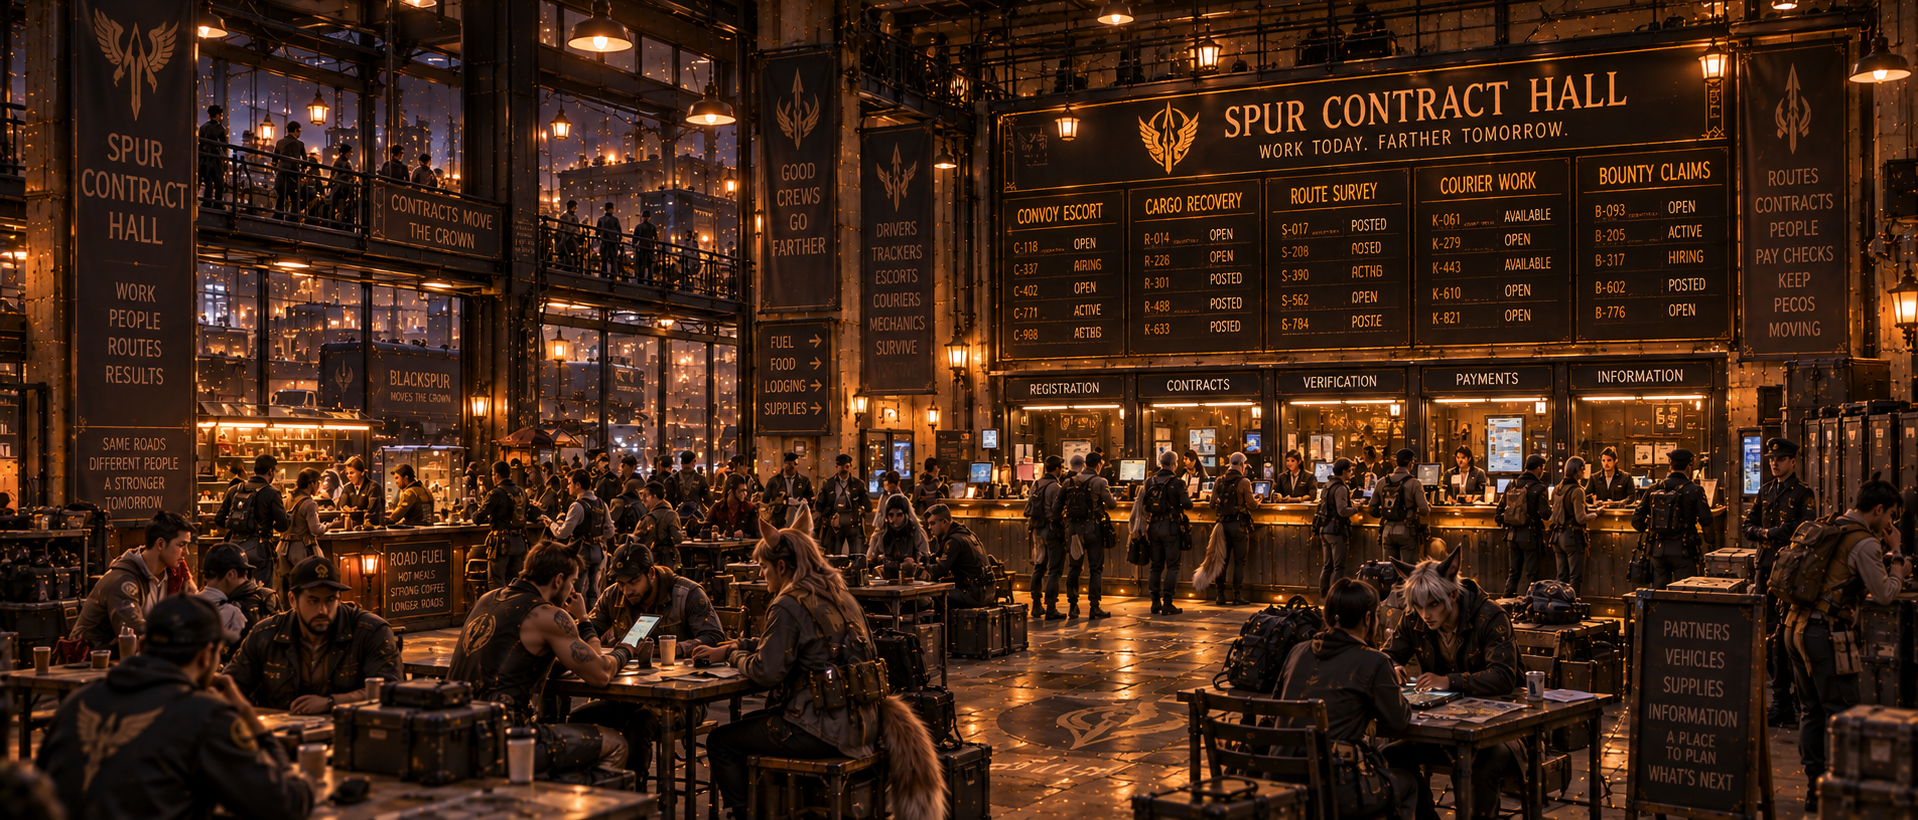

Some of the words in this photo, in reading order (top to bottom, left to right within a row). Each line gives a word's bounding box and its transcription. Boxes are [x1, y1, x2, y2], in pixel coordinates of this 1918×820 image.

[1224, 100, 1307, 139] SPUR
[1322, 80, 1509, 129] CONTRACT
[1528, 70, 1628, 113] HALL
[1259, 141, 1304, 159] WORK
[1312, 136, 1368, 156] TODAY.
[1378, 130, 1452, 150] FARTHER
[1461, 121, 1568, 144] TOMORROW.
[107, 132, 163, 169] SPUR
[781, 162, 815, 181] GOOD
[1599, 164, 1655, 185] BOUNTY
[1660, 160, 1711, 182] CLAIMS
[1768, 167, 1819, 187] ROUTES
[81, 168, 188, 210] CONTRACT
[1440, 174, 1493, 195] COURIER
[1498, 171, 1537, 191] WORK
[776, 186, 820, 207] CREWS
[1290, 185, 1328, 205] ROUTE
[1333, 182, 1378, 202] SURVEY
[391, 194, 459, 223] CONTRACTS
[463, 209, 493, 231] MOVE
[1145, 196, 1182, 215] CARGO
[1187, 192, 1243, 212] RECOVERY
[1595, 203, 1626, 218] B-093
[1668, 200, 1696, 214] OPEN
[1755, 193, 1834, 214] CONTRACTS
[789, 212, 808, 231] GO
[1017, 205, 1059, 224] CONVOY
[1063, 202, 1103, 221] ESCORT
[1432, 213, 1460, 227] K-061
[1504, 207, 1551, 223] AVAILABLE
[109, 211, 163, 245] HALL
[409, 222, 431, 242] THE
[435, 227, 475, 249] CROWN
[876, 220, 917, 238] DRIVERS
[1281, 222, 1309, 236] S-017
[1351, 217, 1387, 232] POSTED
[1595, 228, 1626, 242] B-205
[1668, 224, 1703, 239] ACTIVE
[1770, 219, 1819, 238] PEOPLE
[1013, 240, 1039, 254] C-118
[1073, 237, 1096, 250] OPEN
[1144, 232, 1170, 246] R-014
[1209, 227, 1233, 241] OPEN
[1432, 236, 1461, 250] K-279
[1504, 232, 1531, 247] OPEN
[772, 236, 826, 257] FARTHER
[871, 244, 922, 262] TRACKERS
[1281, 245, 1309, 258] S-208
[1756, 247, 1779, 265] PAY
[1783, 245, 1834, 264] CHECKS
[1144, 254, 1170, 267] R-226
[1209, 249, 1234, 263] OPEN
[1432, 261, 1461, 274] K-443
[1504, 256, 1551, 271] AVAILABLE
[1595, 253, 1625, 267] B-317
[1668, 249, 1704, 264] HIRING
[875, 268, 918, 285] ESCORTS
[1013, 262, 1039, 276] C-337
[1281, 268, 1310, 282] S-390
[1144, 277, 1170, 290] R-301
[1210, 272, 1243, 285] POSTED
[1595, 280, 1626, 294] B-602
[1668, 277, 1706, 292] POSTED
[1778, 271, 1811, 288] KEEP
[115, 282, 156, 303] WORK
[1013, 284, 1039, 297] C-402
[1073, 281, 1096, 294] OPEN
[1432, 286, 1461, 300] K-610
[1504, 284, 1531, 297] OPEN
[873, 291, 921, 308] COURIERS
[1144, 300, 1170, 313] R-488
[1210, 296, 1243, 310] POSTED
[1281, 293, 1309, 307] S-562
[1351, 290, 1378, 304] OPEN
[1774, 296, 1815, 313] PECOS
[109, 309, 161, 330] PEOPLE
[1013, 306, 1038, 319] C-771
[1073, 303, 1102, 317] ACTIVE
[1432, 311, 1460, 325] K-821
[1504, 308, 1531, 322] OPEN
[1595, 305, 1626, 320] B-776
[1668, 303, 1696, 317] OPEN
[869, 315, 925, 332] MECHANICS
[1210, 320, 1241, 333] POSTED
[1769, 320, 1821, 338] MOVING
[108, 337, 161, 358] ROUTES
[770, 335, 794, 349] FUEL
[876, 339, 917, 356] SURVIVE
[770, 357, 796, 371] FOOD
[105, 365, 164, 385] RESULTS
[390, 369, 450, 389] BLACKSPUR
[1303, 374, 1377, 389] VERIFICATION
[1455, 372, 1519, 386] PAYMENTS
[1597, 368, 1683, 384] INFORMATION
[764, 379, 806, 393] LODGING
[1029, 381, 1100, 396] REGISTRATION
[1166, 378, 1230, 392] CONTRACTS
[390, 391, 413, 402] MOVES
[415, 392, 426, 402] THE
[764, 401, 807, 416] SUPPLIES
[102, 437, 130, 451] SAME
[134, 437, 166, 451] ROADS
[89, 457, 141, 471] DIFFERENT
[144, 457, 179, 470] PEOPLE
[104, 477, 111, 490] A
[115, 476, 165, 490] STRONGER
[105, 496, 163, 510] TOMORROW
[390, 551, 418, 566] ROAD
[421, 549, 446, 564] FUEL
[398, 571, 412, 582] HOT
[414, 570, 436, 580] MEALS
[1663, 620, 1730, 641] PARTNERS
[1665, 648, 1725, 670] VEHICLES
[1663, 675, 1724, 698] SUPPLIES
[1648, 703, 1738, 728] INFORMATION
[1666, 730, 1675, 744] A
[1679, 731, 1716, 748] PLACE
[1665, 746, 1682, 761] TO
[1685, 748, 1717, 765] PLAN
[1648, 764, 1696, 787] WHAT'S
[1700, 771, 1734, 792] NEXT
